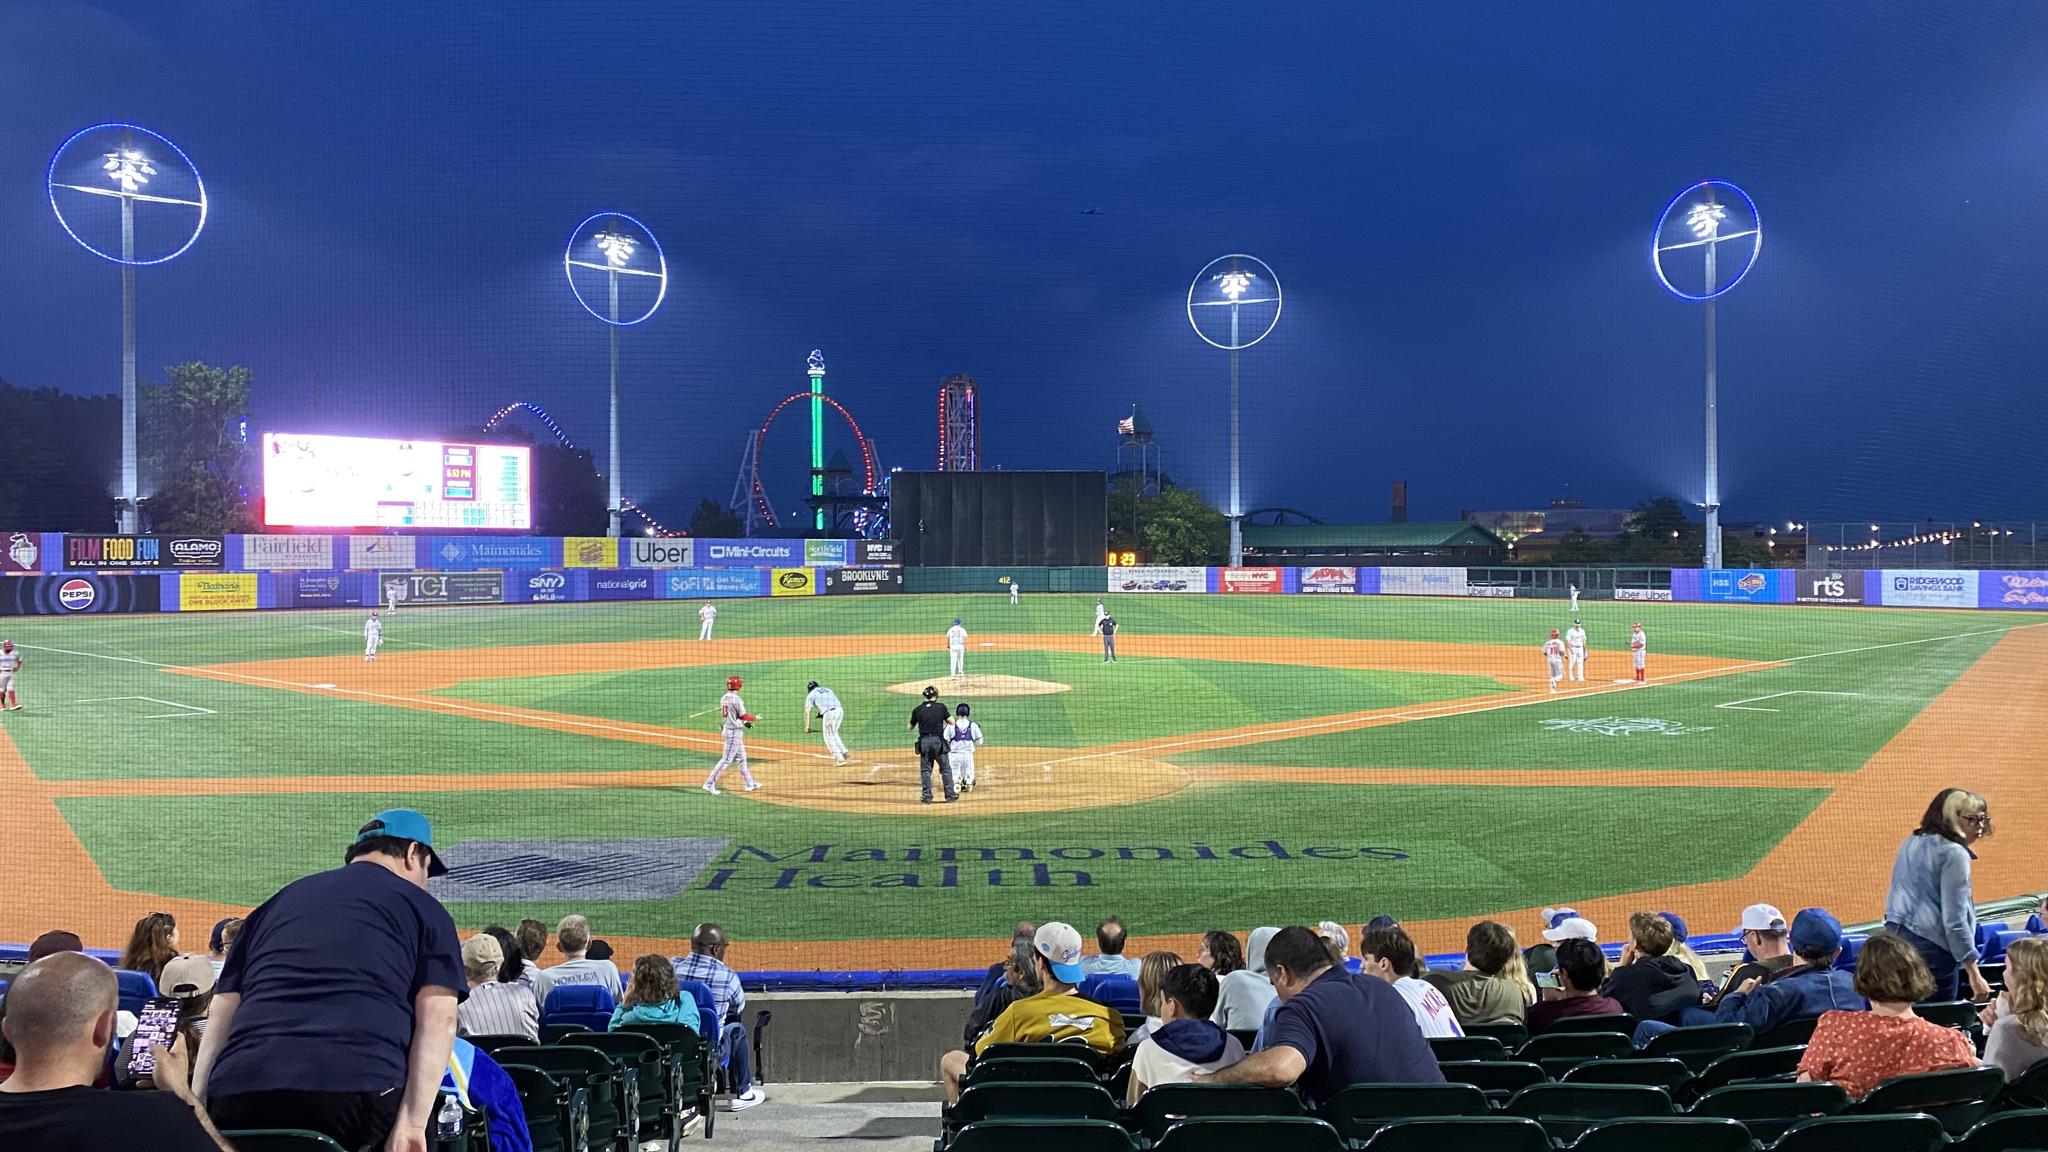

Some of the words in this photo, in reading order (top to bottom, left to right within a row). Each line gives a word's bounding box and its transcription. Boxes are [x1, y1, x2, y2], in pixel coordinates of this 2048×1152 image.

[70, 538, 100, 560] FILM
[103, 538, 134, 560] FOOD
[136, 538, 159, 560] FUN
[174, 543, 217, 551] ALAMO
[252, 537, 322, 554] Fairfield
[471, 543, 542, 557] Maimonides
[726, 545, 790, 558] Mini-Circuits
[809, 544, 843, 553] Northfield
[636, 542, 688, 563] Uber
[841, 570, 881, 582] BROOKLYN
[881, 570, 890, 581] FC
[1910, 577, 1965, 585] RIDGEWOOD
[529, 577, 559, 588] SNY
[597, 579, 647, 591] nationalgrid
[671, 577, 700, 592] SoFi
[1713, 579, 1730, 587] HSS
[1813, 576, 1845, 597] rts
[62, 590, 92, 598] PEPSI
[1467, 587, 1488, 596] Uber
[1491, 587, 1512, 596] Uber
[1616, 588, 1640, 599] Uber
[1645, 589, 1671, 600] Uber
[719, 840, 1409, 863] Maimonides
[694, 863, 1100, 890] Health
